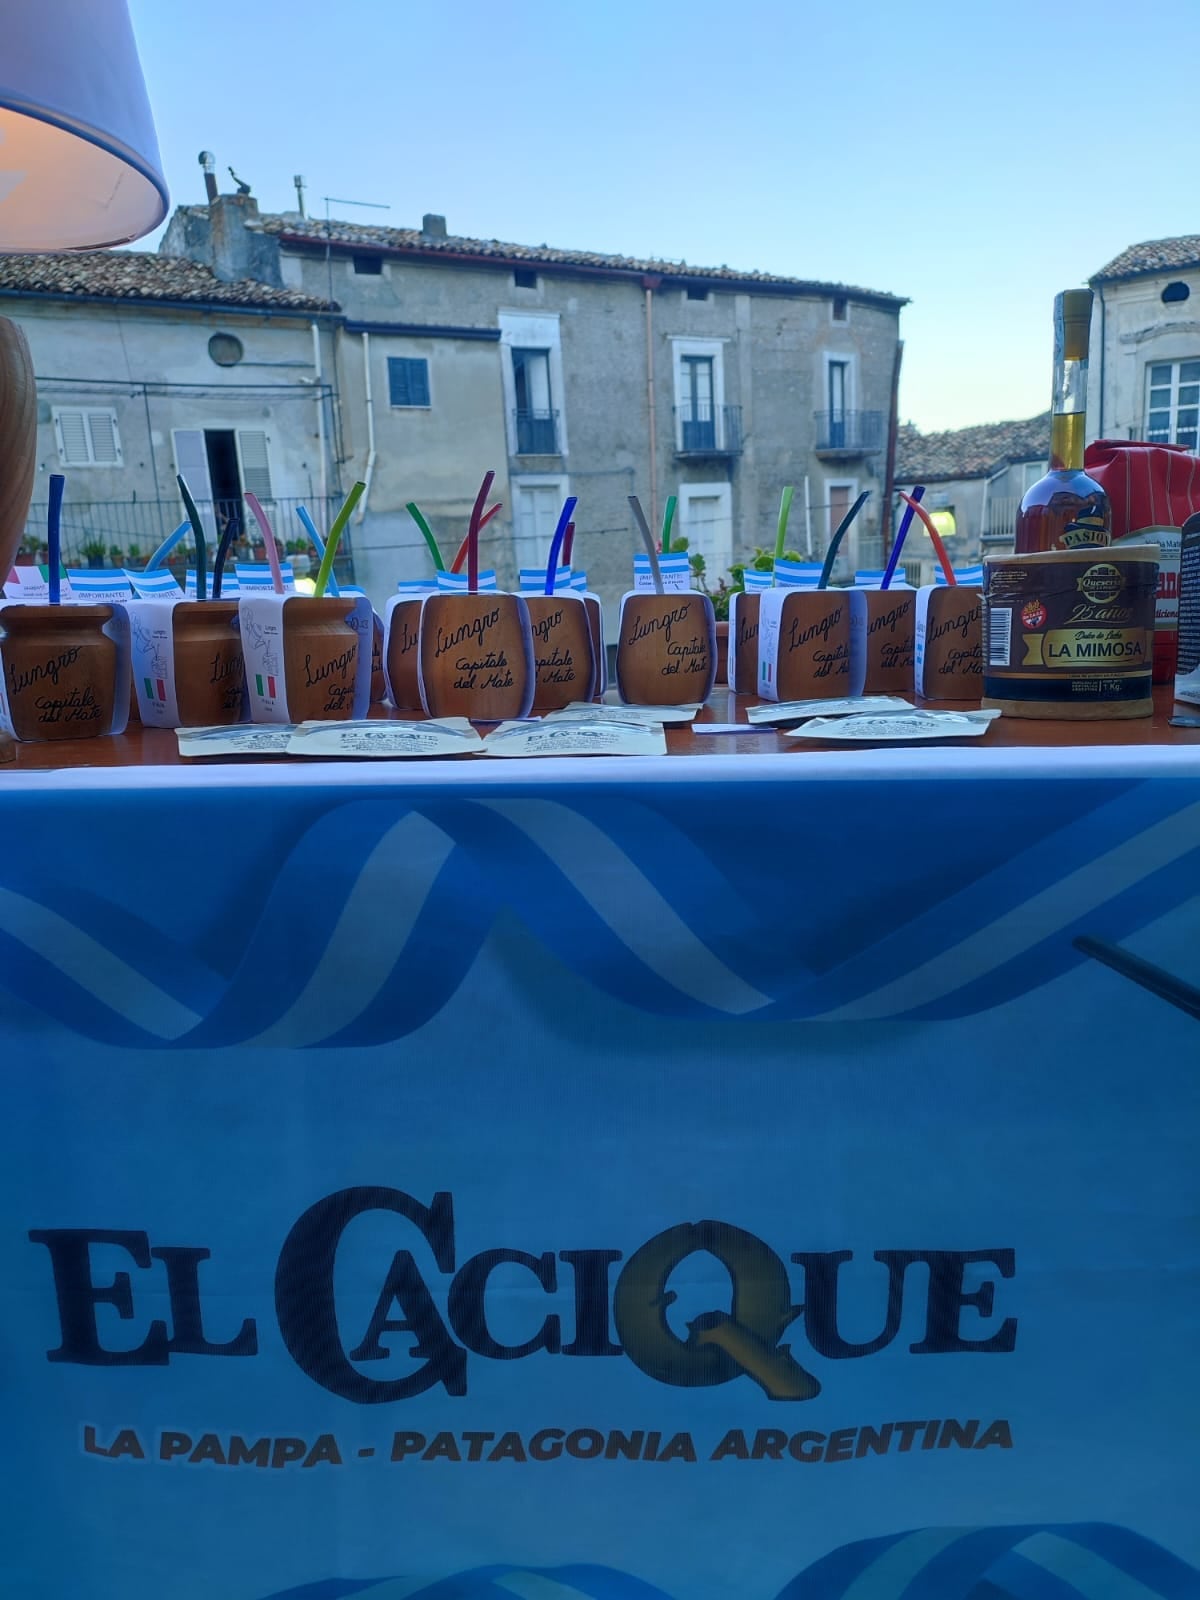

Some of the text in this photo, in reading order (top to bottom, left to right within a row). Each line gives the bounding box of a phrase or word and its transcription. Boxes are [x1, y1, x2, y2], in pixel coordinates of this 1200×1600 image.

[532, 609, 563, 643] ngro
[628, 602, 691, 646] Lungro
[1066, 603, 1096, 623] 25
[435, 608, 500, 657] Lungro
[789, 605, 843, 652] Lungro
[455, 650, 508, 672] Capitale
[1048, 641, 1143, 658] LA MIMOSA
[9, 646, 81, 695] Lungro
[454, 674, 475, 690] del
[480, 669, 515, 690] Mate
[542, 667, 576, 683] Mate
[661, 659, 680, 676] del
[938, 661, 983, 674] del Ma
[28, 1185, 1018, 1404] EL CACIQUE
[83, 1425, 145, 1459] LA
[159, 1431, 343, 1469] PAMPA
[390, 1428, 698, 1462] PATAGONIA
[710, 1418, 1014, 1463] ARGENTINA
